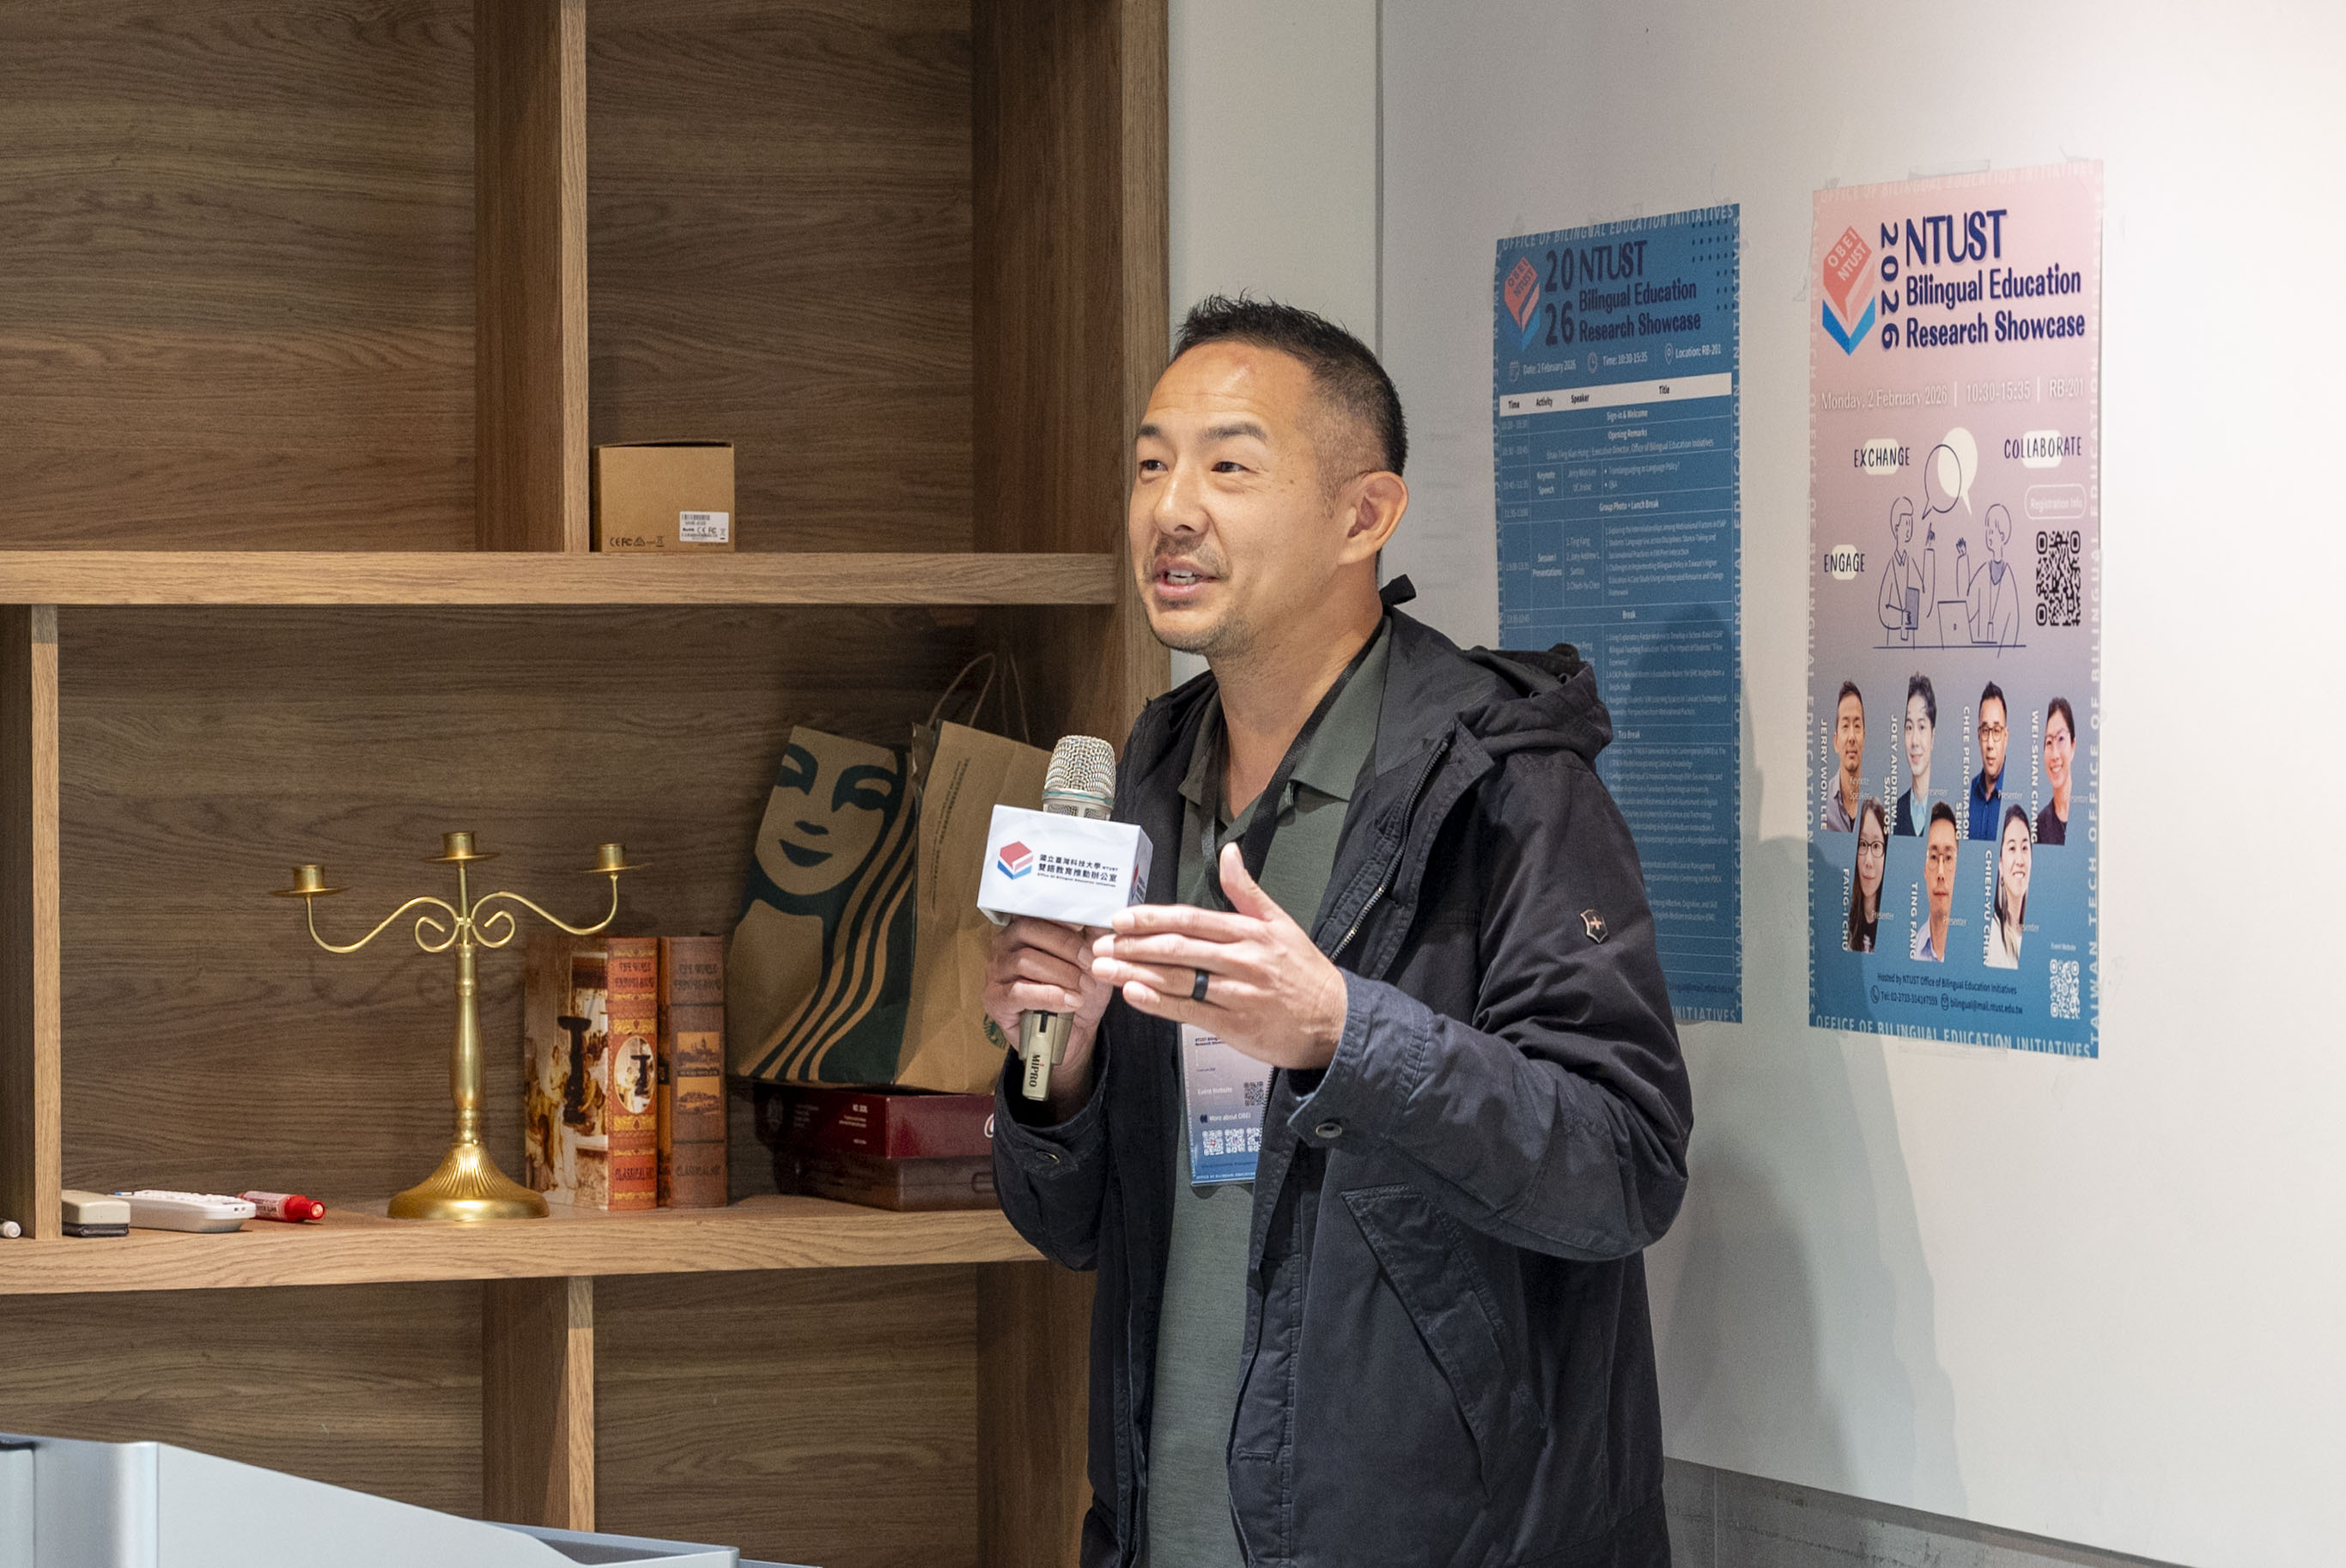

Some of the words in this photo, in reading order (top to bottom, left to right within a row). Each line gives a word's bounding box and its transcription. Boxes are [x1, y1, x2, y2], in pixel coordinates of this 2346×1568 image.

[1503, 231, 1536, 251] OFFICE
[1538, 228, 1553, 246] OF
[1554, 223, 1608, 244] BILINGUAL
[1609, 212, 1667, 234] EDUCATION
[1827, 231, 1858, 269] OBEI
[1905, 209, 2008, 268] NTUST
[1545, 247, 1575, 293] 20
[1579, 240, 1648, 285] NTUST
[1837, 243, 1868, 283] NTUST
[1578, 289, 1631, 314] Bilingual
[1634, 277, 1697, 306] Education
[1881, 222, 1899, 350] 2026
[1906, 269, 1983, 310] Bilingual
[1989, 262, 2082, 300] Education
[1545, 301, 1575, 346] 26
[1578, 316, 1635, 343] Research
[1638, 313, 1701, 337] Showcase
[1906, 312, 1988, 349] Research
[1994, 310, 2086, 343] Showcase
[1602, 355, 1618, 367] Time:
[1675, 346, 1701, 359] Location:
[1508, 399, 1520, 410] Time
[1535, 395, 1553, 408] Activity
[1571, 393, 1590, 405] Speaker
[1658, 385, 1670, 396] Title
[1820, 392, 1866, 411] Monday,
[1868, 390, 1875, 408] 2
[1875, 386, 1922, 409] February
[1924, 384, 1948, 404] 2026
[1966, 379, 2031, 404] 10:30-15:35
[2049, 376, 2084, 398] RB-201
[1853, 447, 1911, 468] EXCHANGE
[2003, 436, 2082, 459] COLLABORATE
[1823, 553, 1865, 573] ENGAGE
[2090, 696, 2100, 730] OF
[2031, 710, 2039, 787] WEI-SHAN
[2088, 744, 2099, 843] OFFICE
[1954, 802, 1963, 840] SENG
[2030, 789, 2039, 844] CHANG
[1910, 881, 1918, 918] TING
[1984, 849, 1993, 921] CHIEH-YU
[2088, 856, 2098, 927] TECH
[1841, 920, 1850, 952] CHU
[1909, 921, 1918, 960] FANG
[1983, 924, 1991, 967] CHEN
[1902, 975, 1920, 986] NTUST
[2088, 941, 2100, 1045] TAIWAN
[1816, 1015, 1855, 1031] OFFICE
[1859, 1019, 1873, 1034] OF
[1877, 1022, 1938, 1042] BILINGUAL
[1943, 1028, 2012, 1050] EDUCATION
[2016, 1036, 2091, 1059] INITIATIVES
